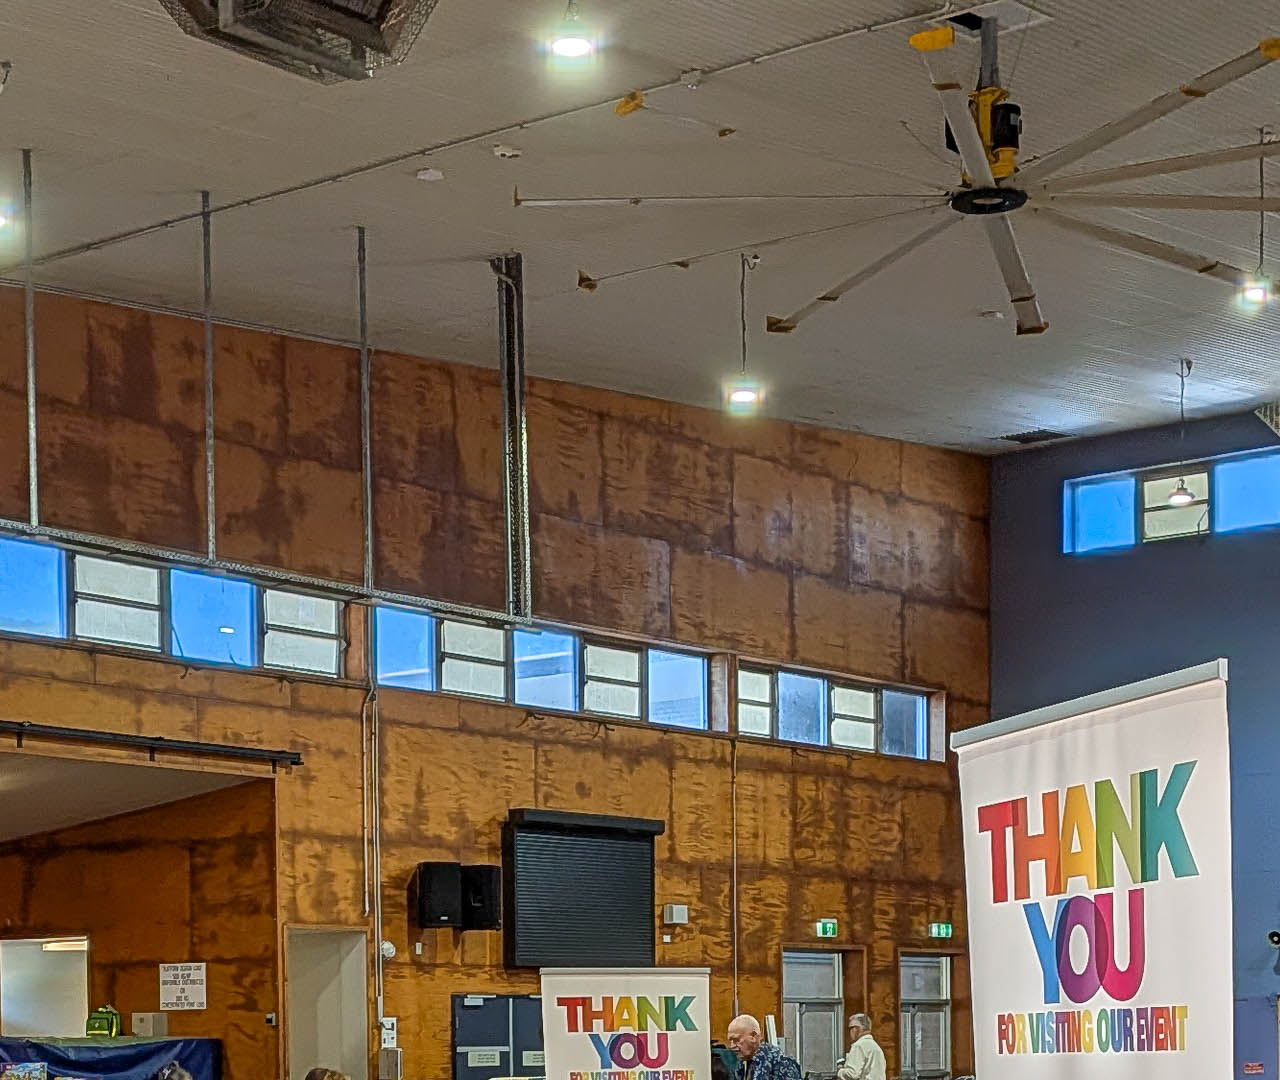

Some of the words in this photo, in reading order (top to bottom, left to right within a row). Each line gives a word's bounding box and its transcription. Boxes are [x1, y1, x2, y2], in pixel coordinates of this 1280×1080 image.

[978, 760, 1200, 904] THANK
[1023, 888, 1145, 1004] YOU
[556, 995, 699, 1033] THANK
[998, 1012, 1026, 1055] FOR
[1028, 1009, 1093, 1054] VISITING
[1096, 1007, 1135, 1053] OUR
[1136, 1005, 1188, 1052] EVENT
[588, 1033, 669, 1069] YOU
